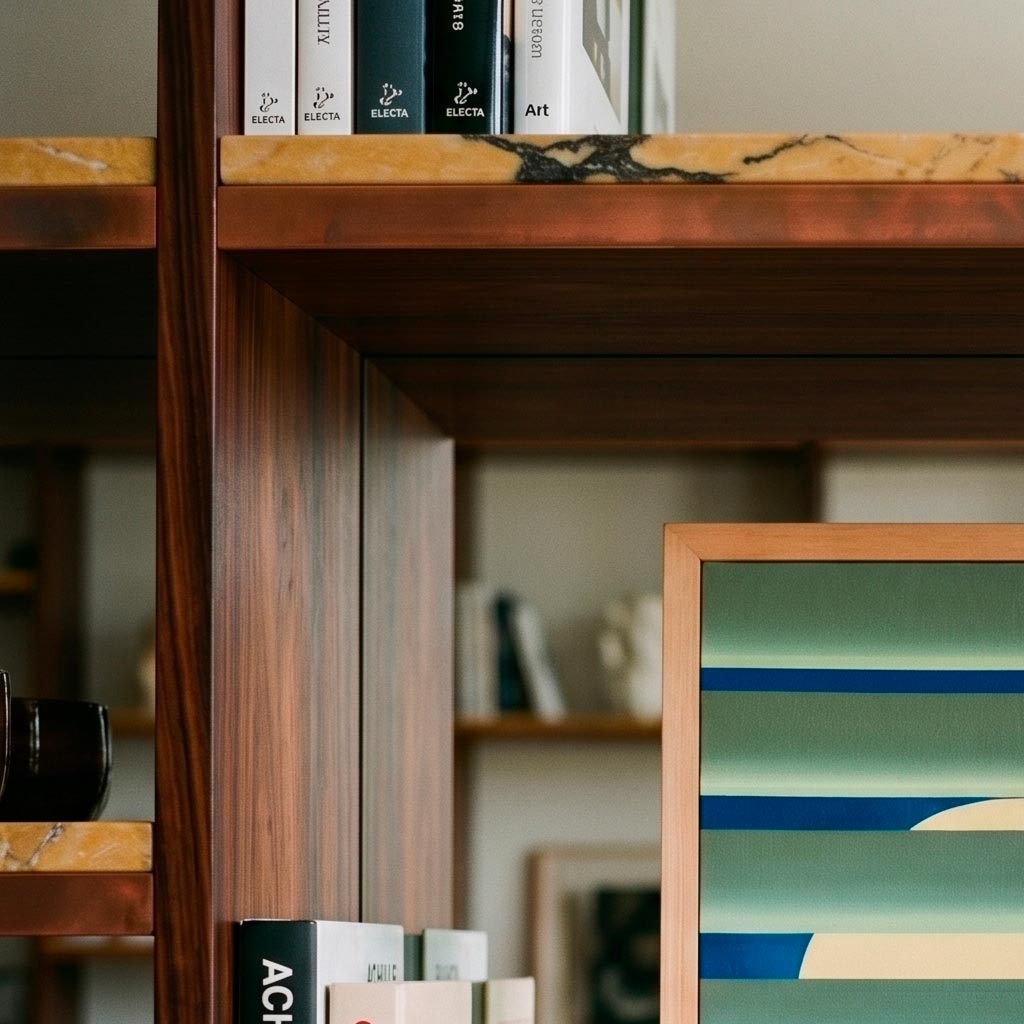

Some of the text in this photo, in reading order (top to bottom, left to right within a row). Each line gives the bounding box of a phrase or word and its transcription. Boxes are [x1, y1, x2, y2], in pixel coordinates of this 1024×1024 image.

[370, 108, 409, 118] ELECTA
[446, 107, 485, 118] ELECTA
[524, 103, 550, 117] Art
[251, 115, 286, 124] ELECTA
[304, 112, 341, 122] ELECTA
